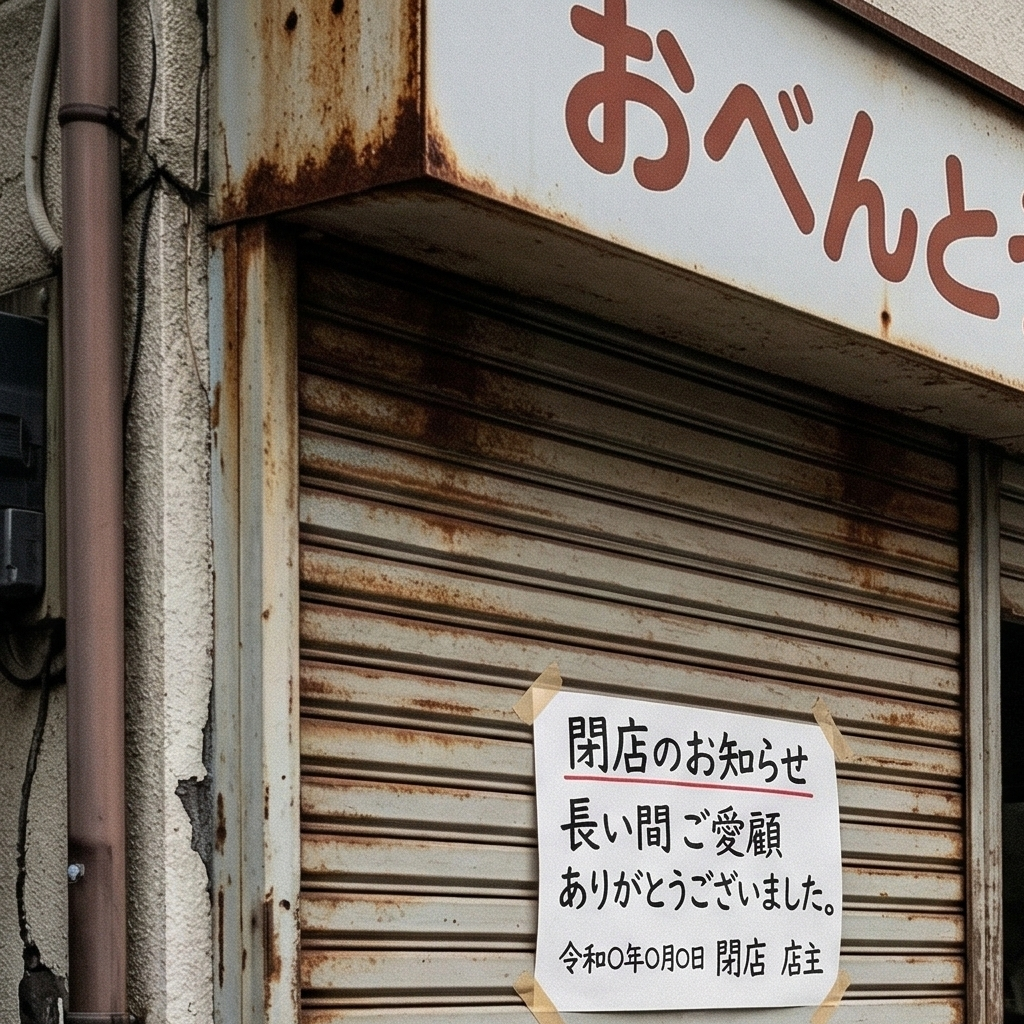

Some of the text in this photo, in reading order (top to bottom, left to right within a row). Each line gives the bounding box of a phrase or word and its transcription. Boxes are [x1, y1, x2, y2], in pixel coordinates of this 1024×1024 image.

[568, 716, 809, 784] 閉店のお知らせ
[560, 797, 783, 858] 長い間 ご愛顧
[559, 866, 834, 916] ありがとうございました。
[716, 937, 767, 977] 閉店
[781, 939, 824, 977] 店主
